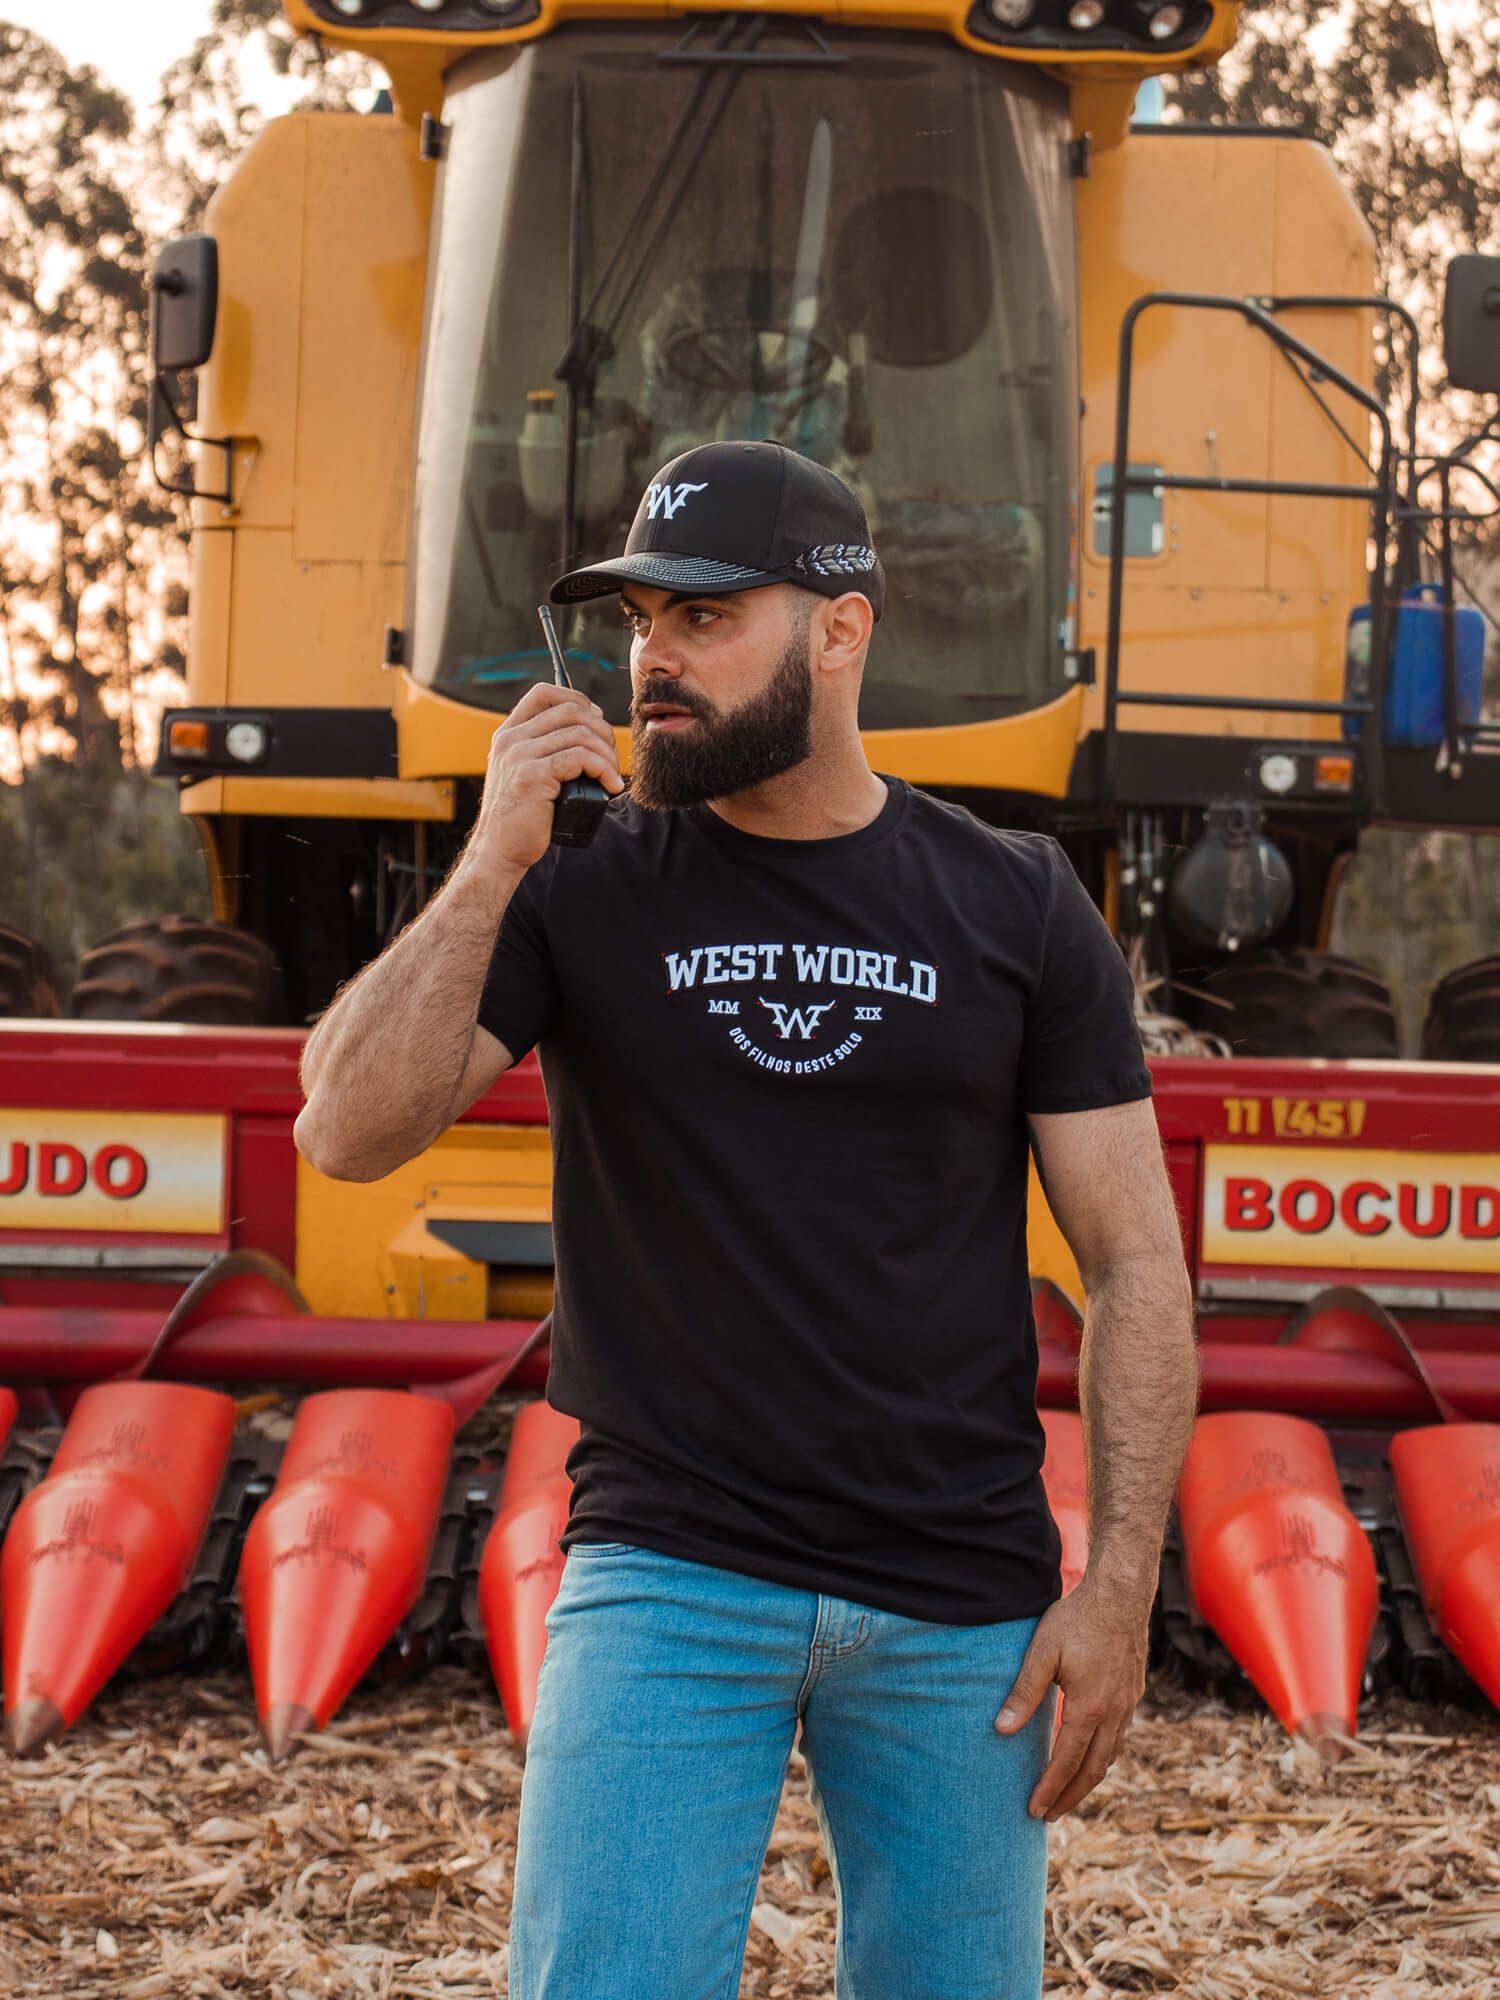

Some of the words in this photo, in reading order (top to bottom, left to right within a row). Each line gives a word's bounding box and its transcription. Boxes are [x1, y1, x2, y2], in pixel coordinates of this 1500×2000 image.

[664, 943, 784, 991] WEST
[792, 943, 938, 1004] WORLD
[707, 999, 740, 1015] MM
[853, 1006, 883, 1021] XIX
[728, 1025, 752, 1051] DOS
[747, 1046, 792, 1074] FILHOS
[794, 1053, 836, 1074] DESTE
[833, 1031, 863, 1061] SOLO
[1223, 1097, 1260, 1134] 11
